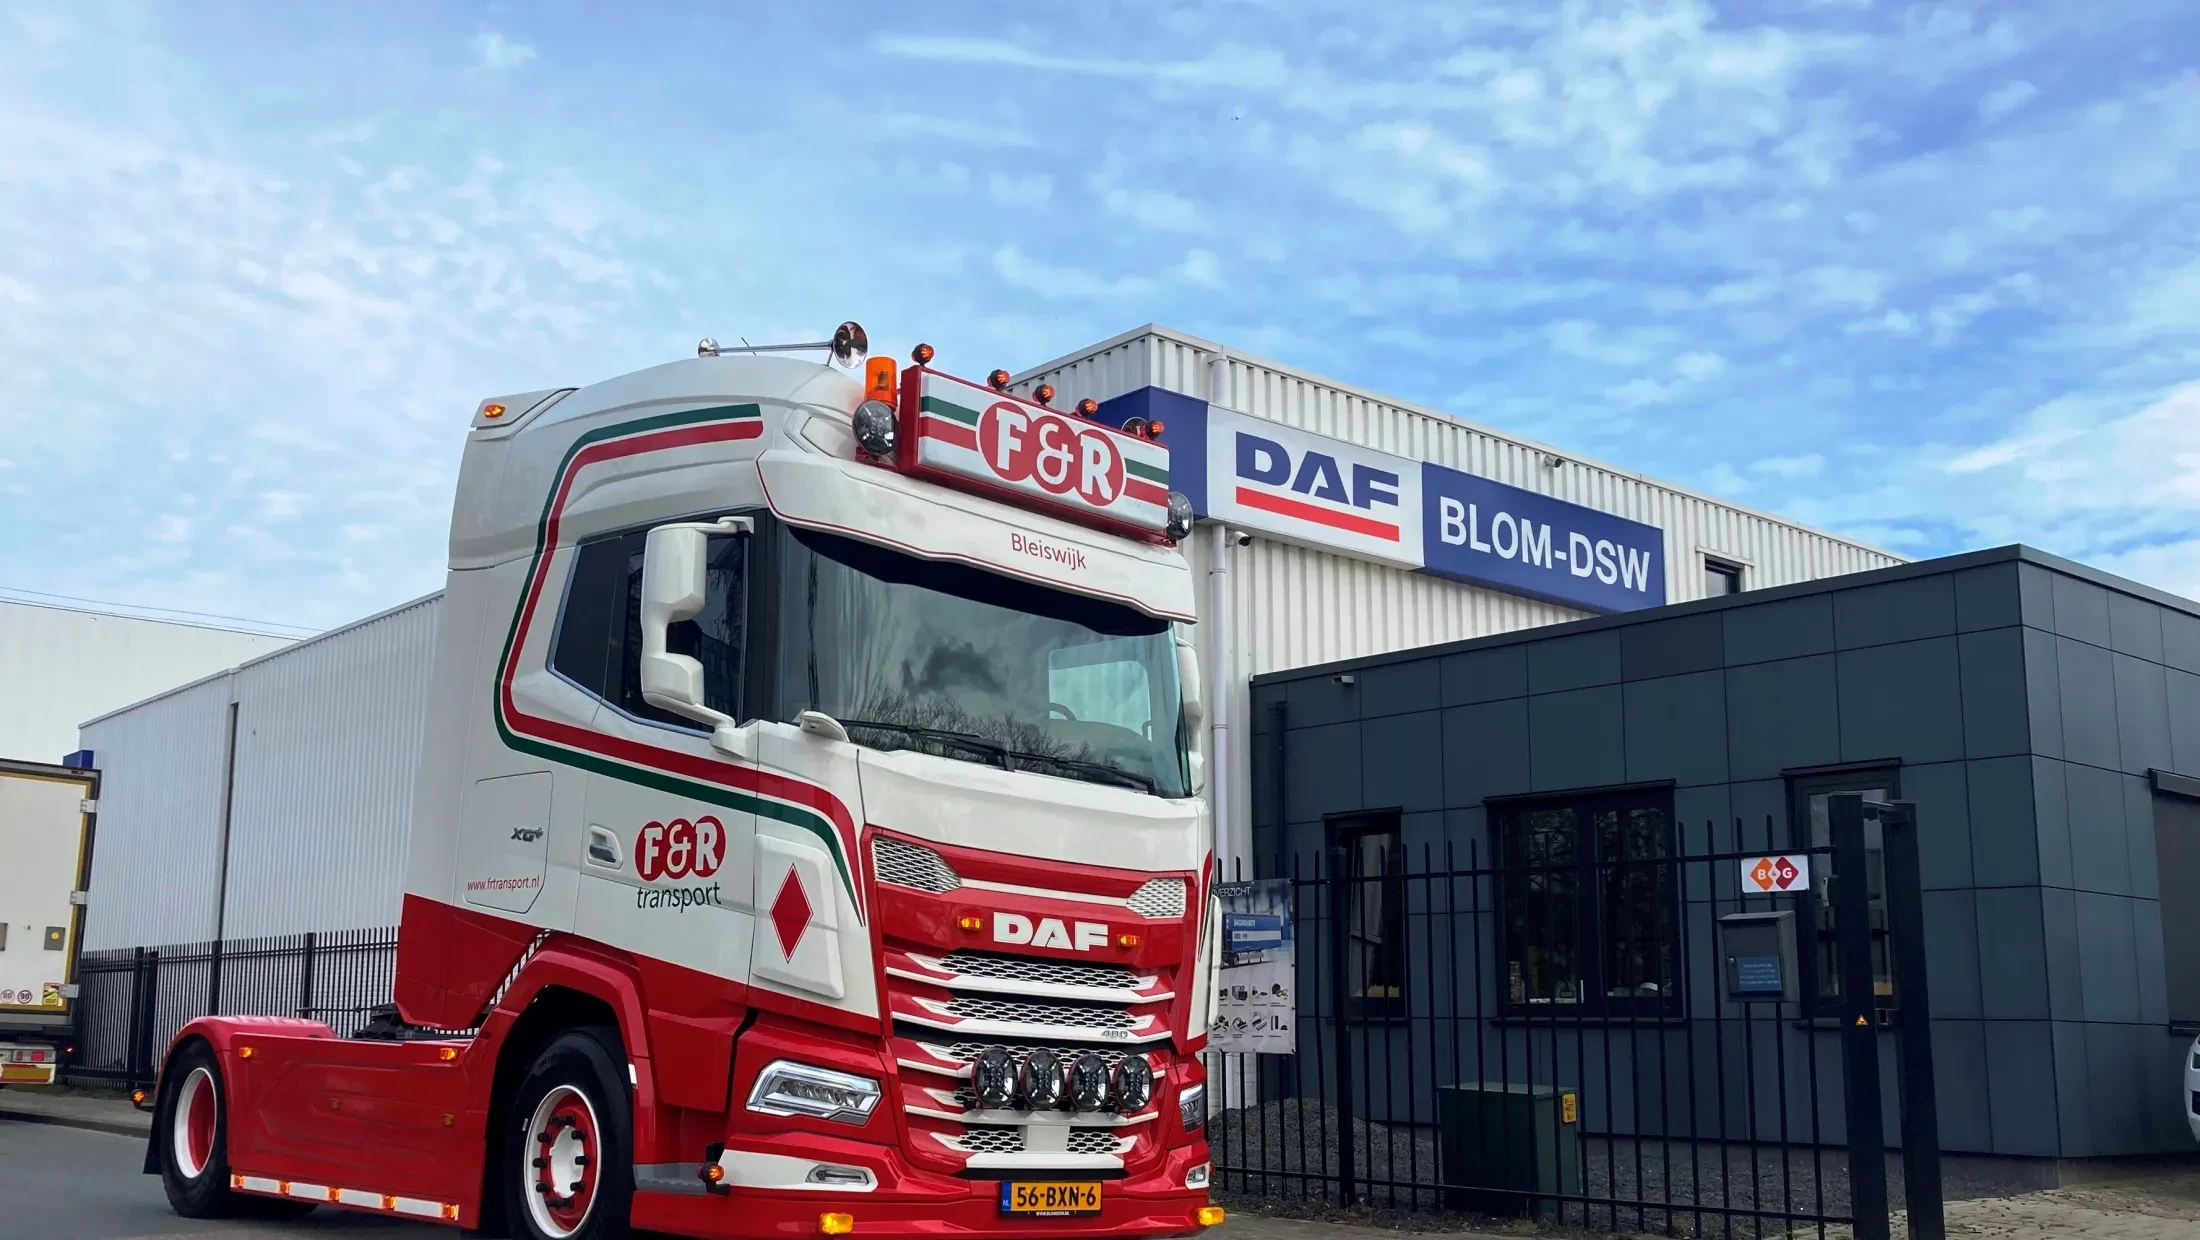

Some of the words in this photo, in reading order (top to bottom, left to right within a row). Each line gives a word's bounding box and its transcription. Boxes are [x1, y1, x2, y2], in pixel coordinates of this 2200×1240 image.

[995, 405, 1113, 502] F&R
[1235, 431, 1399, 510] DAF
[1010, 532, 1087, 571] Bleiswijk
[1440, 496, 1650, 593] BLOM-DSW
[643, 821, 720, 874] F&R
[467, 875, 540, 892] www.frtransport.nl
[636, 881, 722, 913] transport
[993, 912, 1109, 952] DAF
[1016, 1186, 1097, 1208] 56-BXN-6
